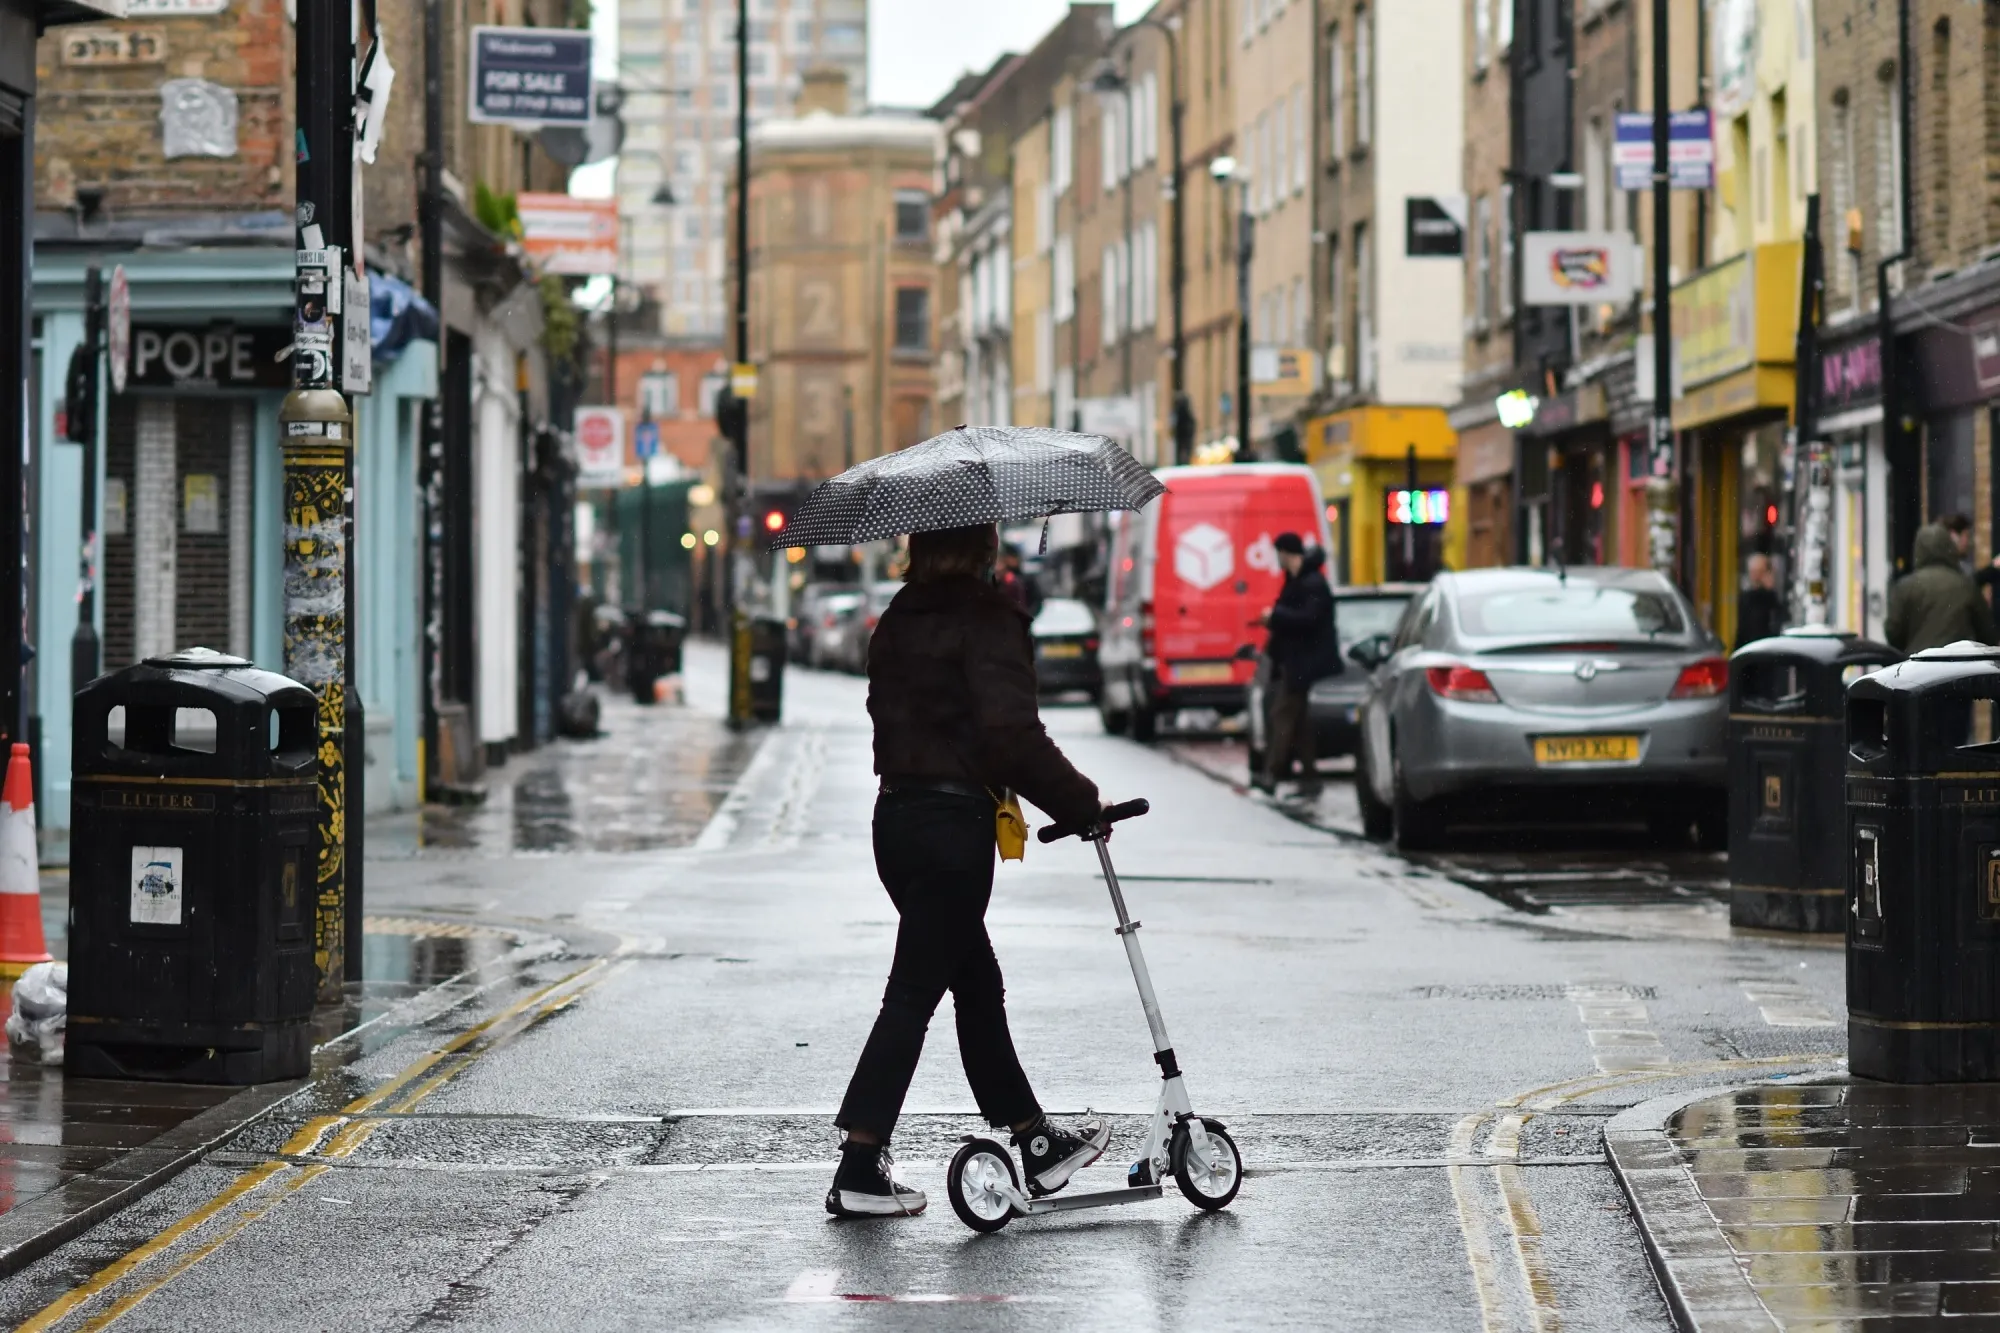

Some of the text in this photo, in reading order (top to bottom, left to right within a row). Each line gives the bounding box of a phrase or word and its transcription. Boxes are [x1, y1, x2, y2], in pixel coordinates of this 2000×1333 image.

[485, 70, 566, 93] FOR SALE
[135, 330, 256, 379] POPE
[122, 792, 194, 808] LITTER
[1963, 789, 1998, 802] LIT
